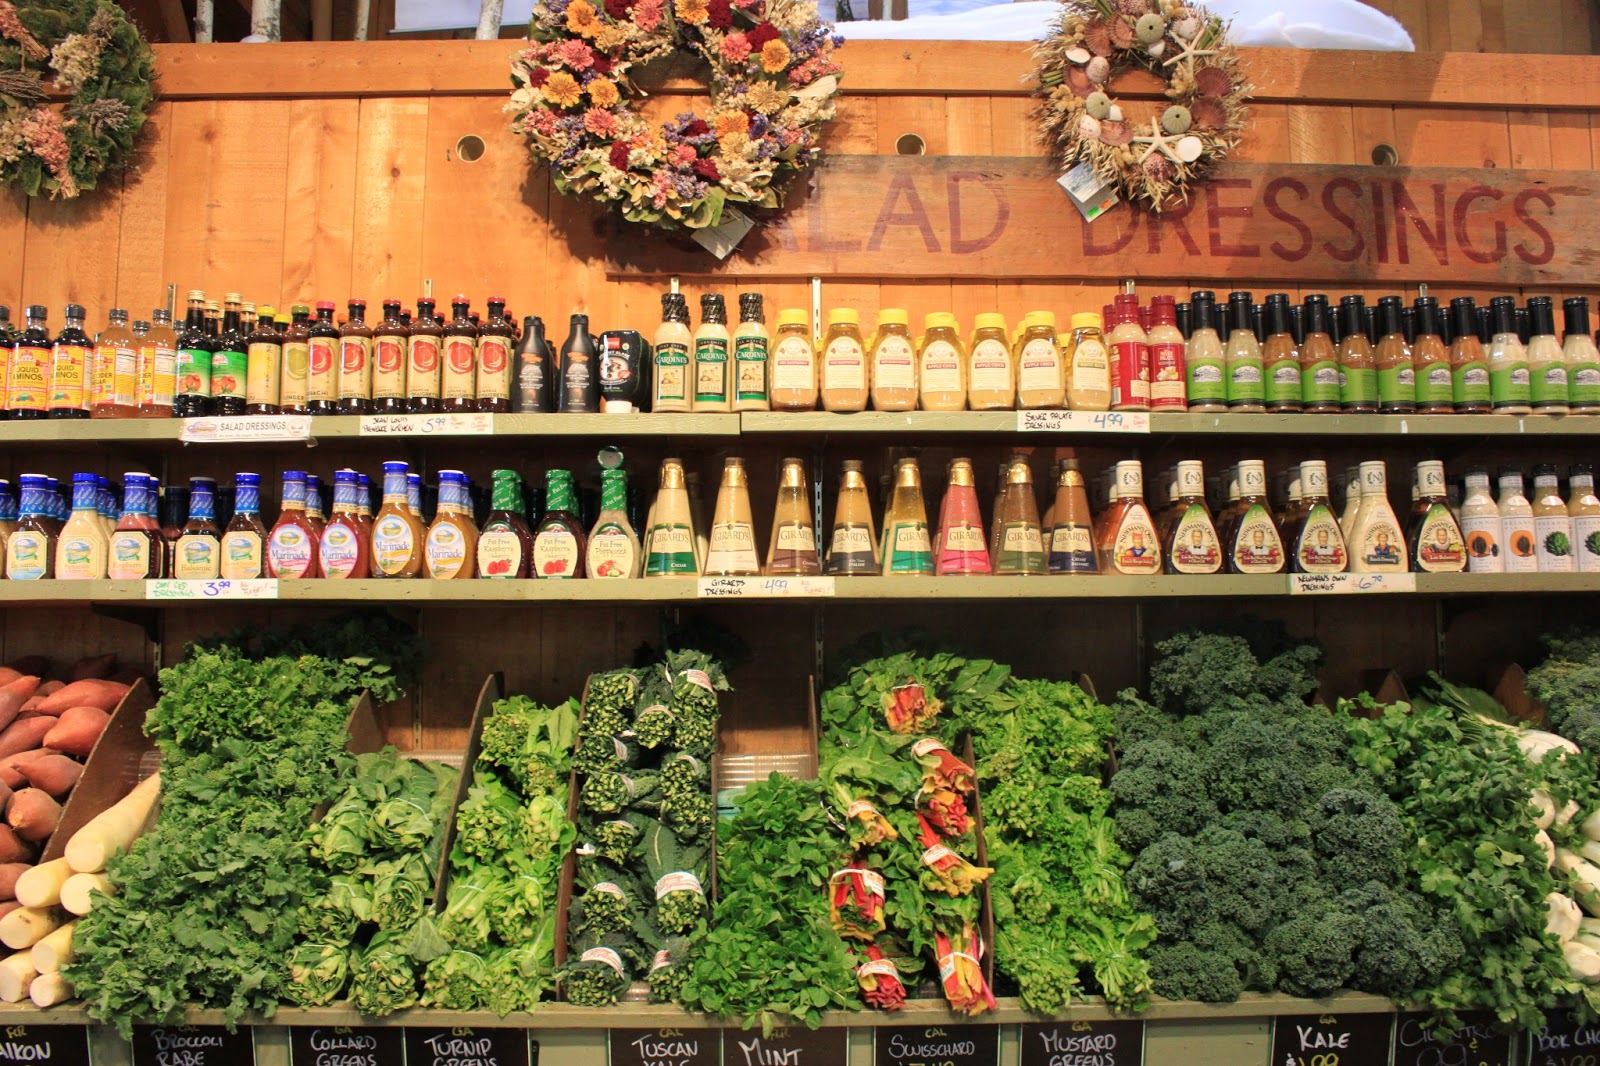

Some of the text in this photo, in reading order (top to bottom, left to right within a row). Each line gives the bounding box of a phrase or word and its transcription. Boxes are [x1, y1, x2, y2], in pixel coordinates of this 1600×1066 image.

[220, 421, 286, 431] SALAD DRESSINGS
[376, 541, 410, 551] Marinade
[271, 549, 307, 560] Marinade
[321, 549, 355, 560] Marinade
[428, 549, 462, 559] Marinade
[334, 1026, 352, 1034] GA
[452, 1026, 474, 1037] GA
[658, 1027, 684, 1038] CAL
[925, 1027, 947, 1038] CAL
[1072, 1021, 1093, 1032] GA
[152, 1028, 223, 1050] BROCCOLI
[310, 1030, 377, 1051] COLLARD
[1039, 1029, 1117, 1052] MUSTARD
[1296, 1025, 1351, 1051] KALE
[1538, 1026, 1571, 1051] BOK
[0, 1041, 51, 1061] AIKON
[424, 1033, 492, 1057] TURNIP
[631, 1034, 698, 1059] TUSCAN
[738, 1037, 803, 1066] MINT
[888, 1034, 976, 1057] SWISSCHARD
[156, 1051, 205, 1066] RABE
[316, 1053, 376, 1066] GREENS
[1050, 1053, 1115, 1066] GREENS
